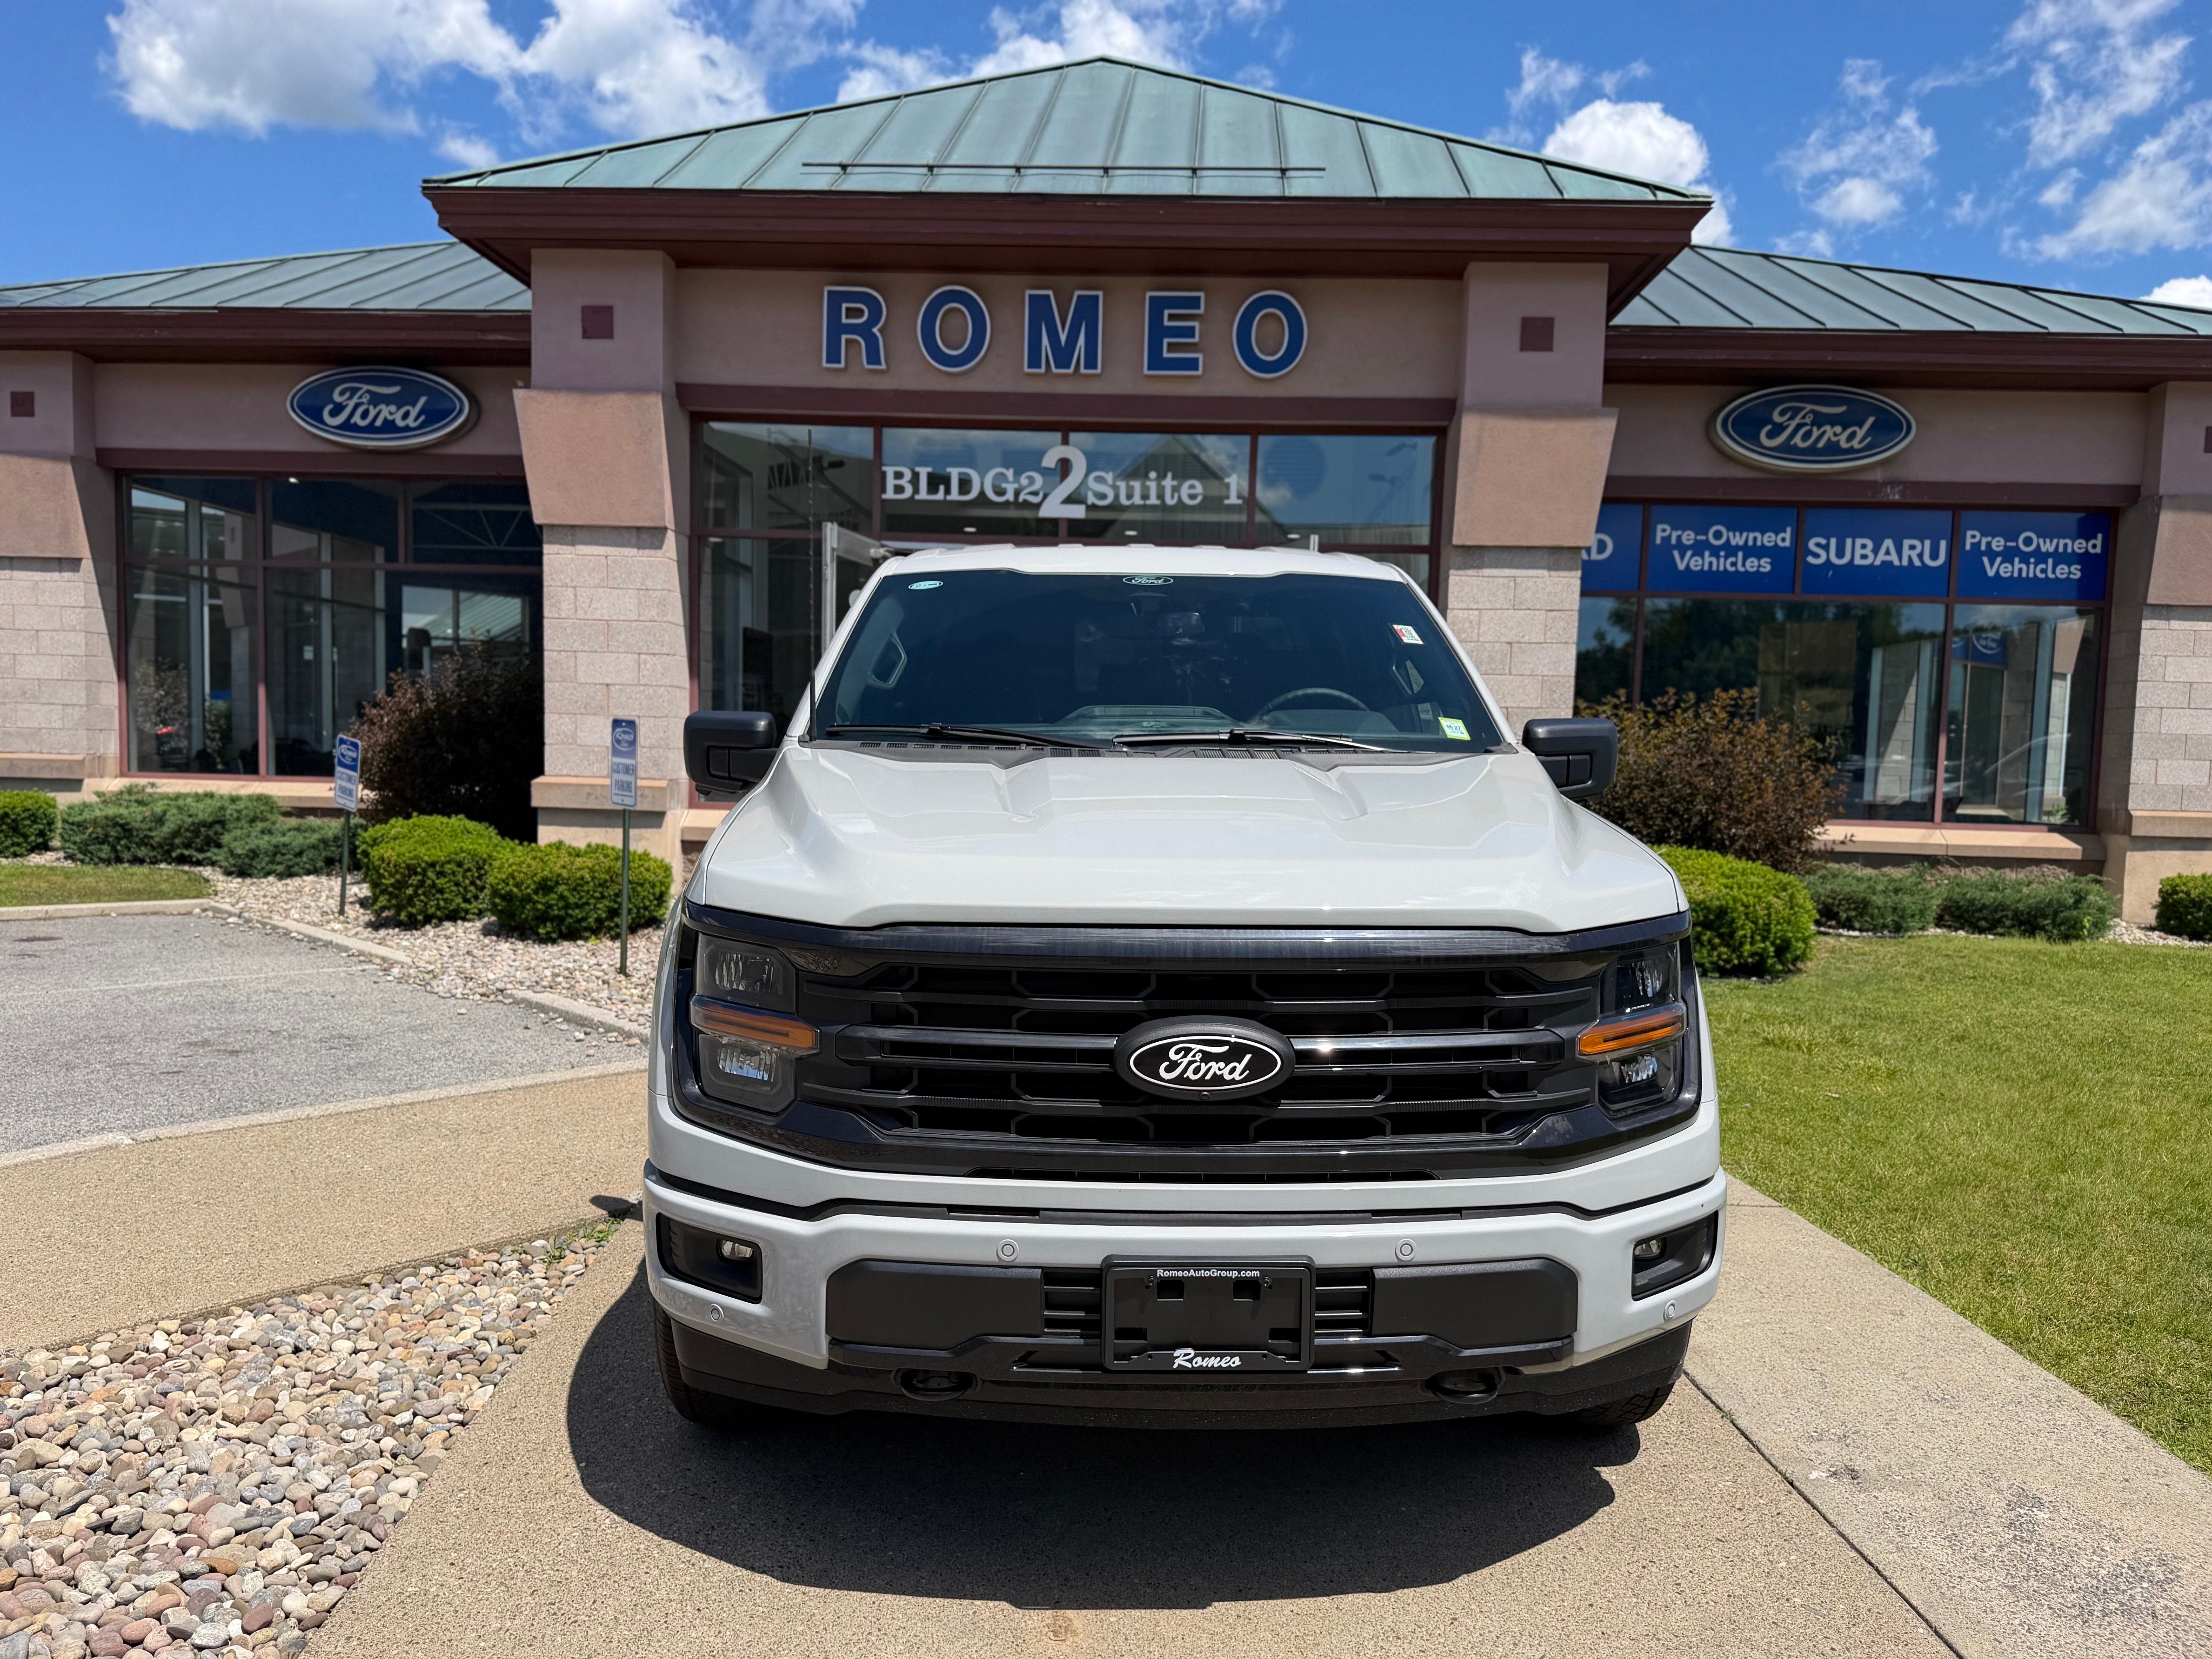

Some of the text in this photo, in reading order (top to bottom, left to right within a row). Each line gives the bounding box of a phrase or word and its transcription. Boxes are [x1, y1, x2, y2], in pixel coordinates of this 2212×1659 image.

[822, 286, 1308, 378] ROMEO
[323, 383, 428, 428] Ford
[1760, 406, 1875, 449] Ford
[1039, 445, 1087, 518] 2
[1087, 471, 1203, 506] Suite
[1224, 474, 1243, 504] 1
[1655, 524, 1792, 547] Pre-Owned
[1965, 530, 2102, 554] Pre-Owned
[1672, 550, 1772, 572] Vehicles
[1806, 537, 1947, 567] SUBARU
[1982, 556, 2082, 579] Vehicles
[613, 761, 635, 776] CUSTOMER
[614, 778, 633, 793] PARKING
[1159, 1043, 1252, 1080] Ford
[1157, 1269, 1260, 1278] RomeoAutoGroup.com
[1173, 1348, 1242, 1369] Romeo
